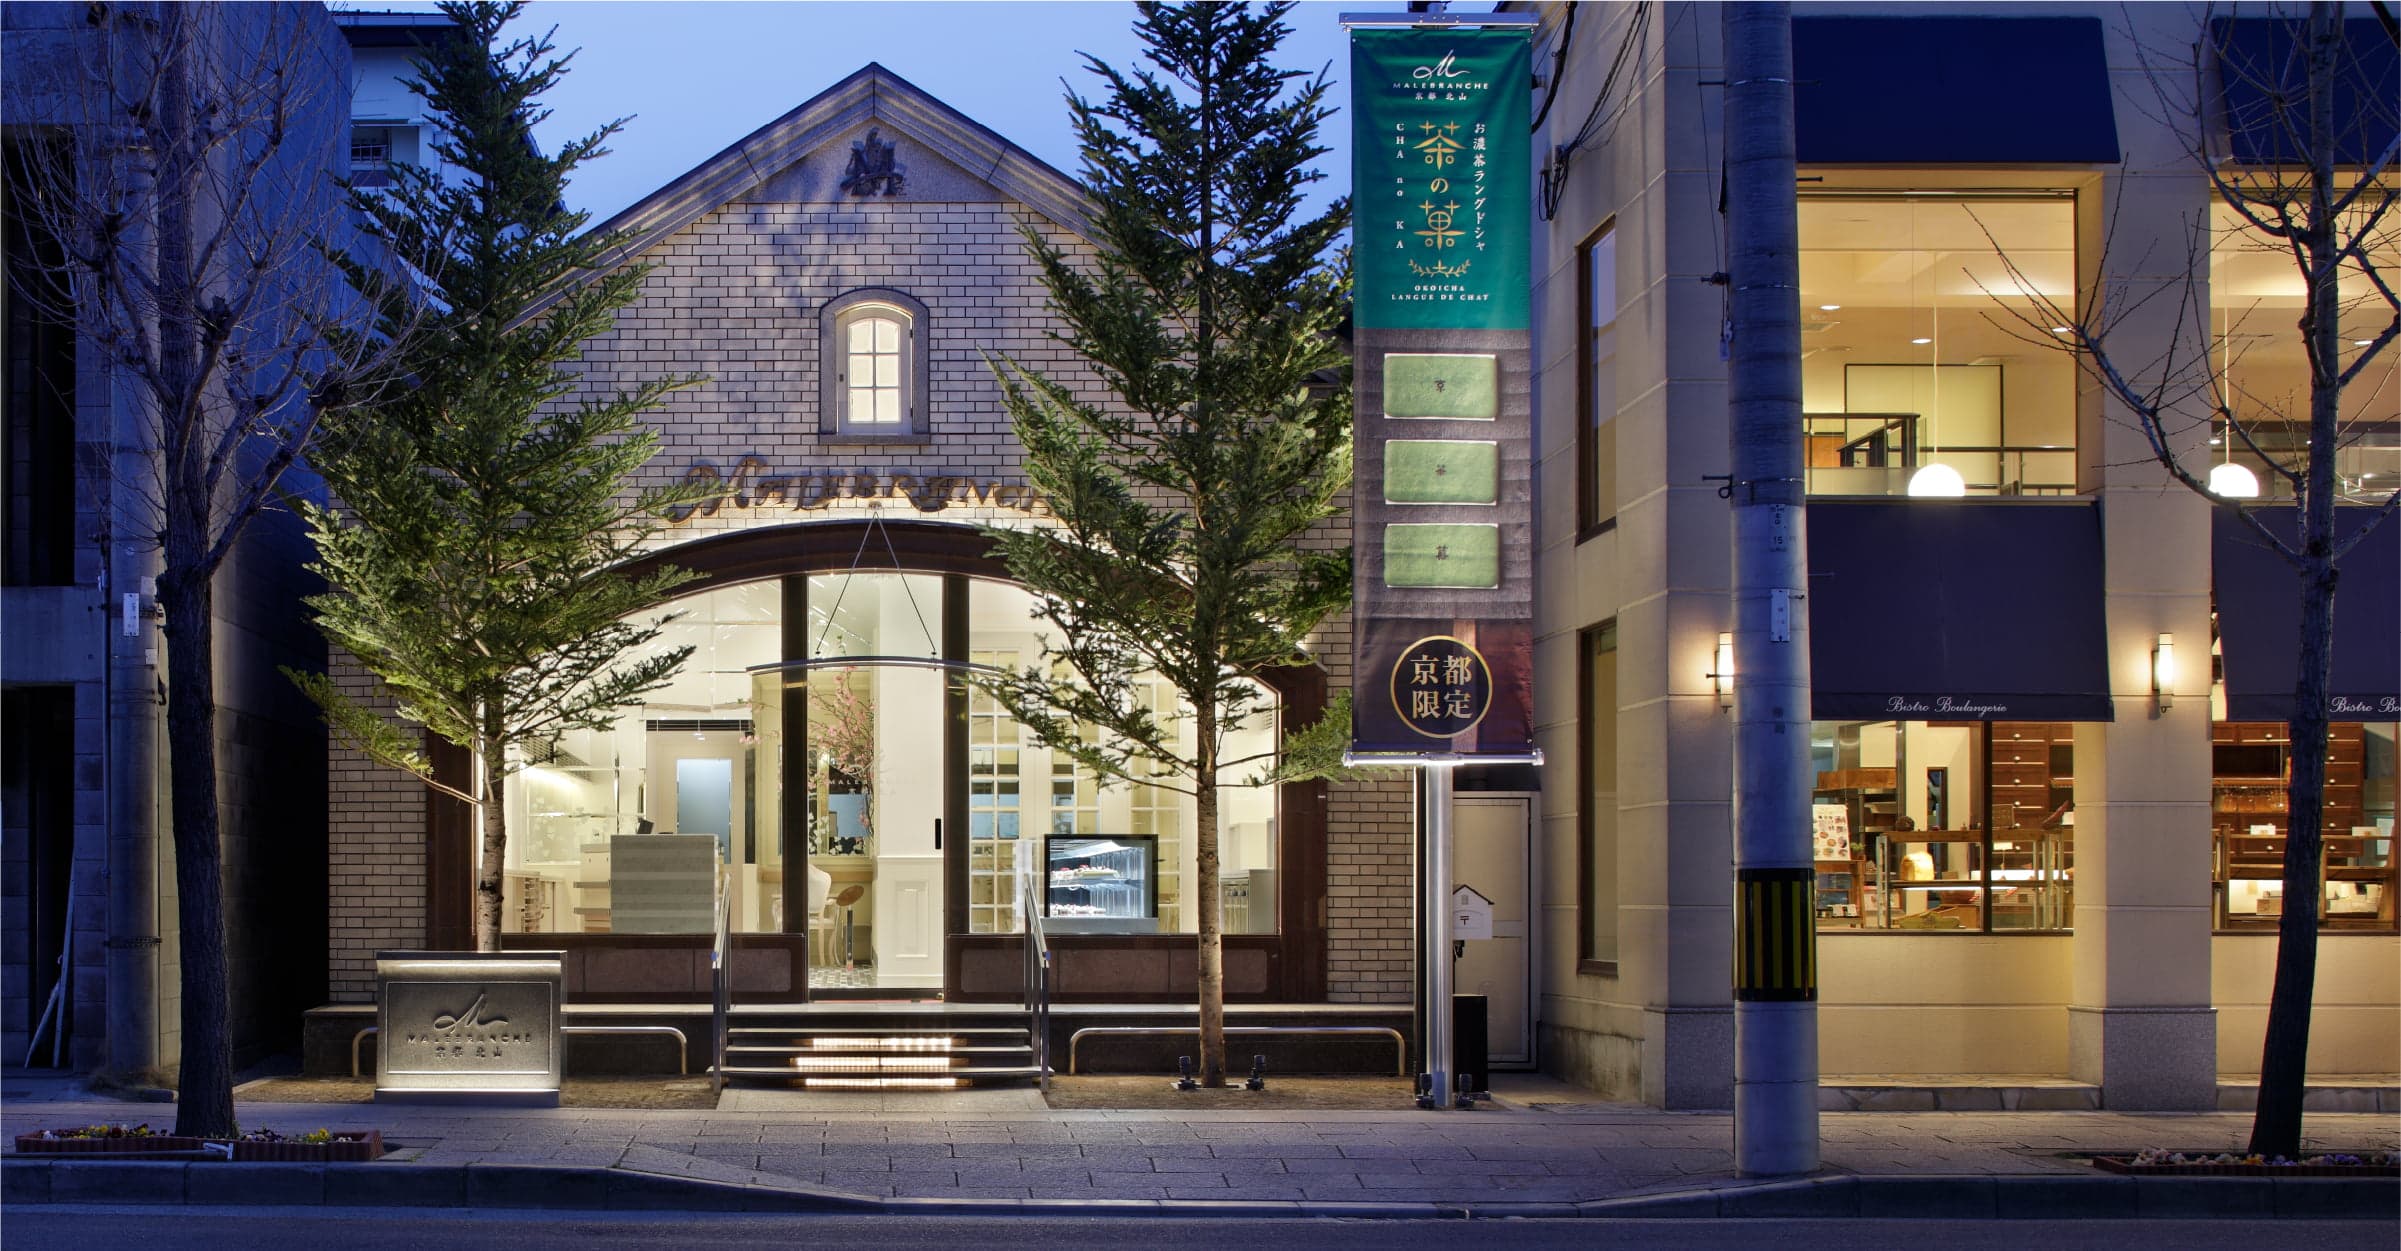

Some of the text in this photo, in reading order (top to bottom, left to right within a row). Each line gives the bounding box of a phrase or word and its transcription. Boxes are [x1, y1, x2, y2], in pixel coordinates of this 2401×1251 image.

[1392, 82, 1489, 90] MALEBRANCHE
[1472, 123, 1486, 251] お濃茶ラングドシャ
[1409, 654, 1473, 687] 京都
[1411, 689, 1473, 720] 限定
[1886, 696, 2007, 718] Bistro Boulangerie
[2329, 697, 2400, 713] Bistro Bo
[406, 1033, 532, 1045] MALEBRANCHE
